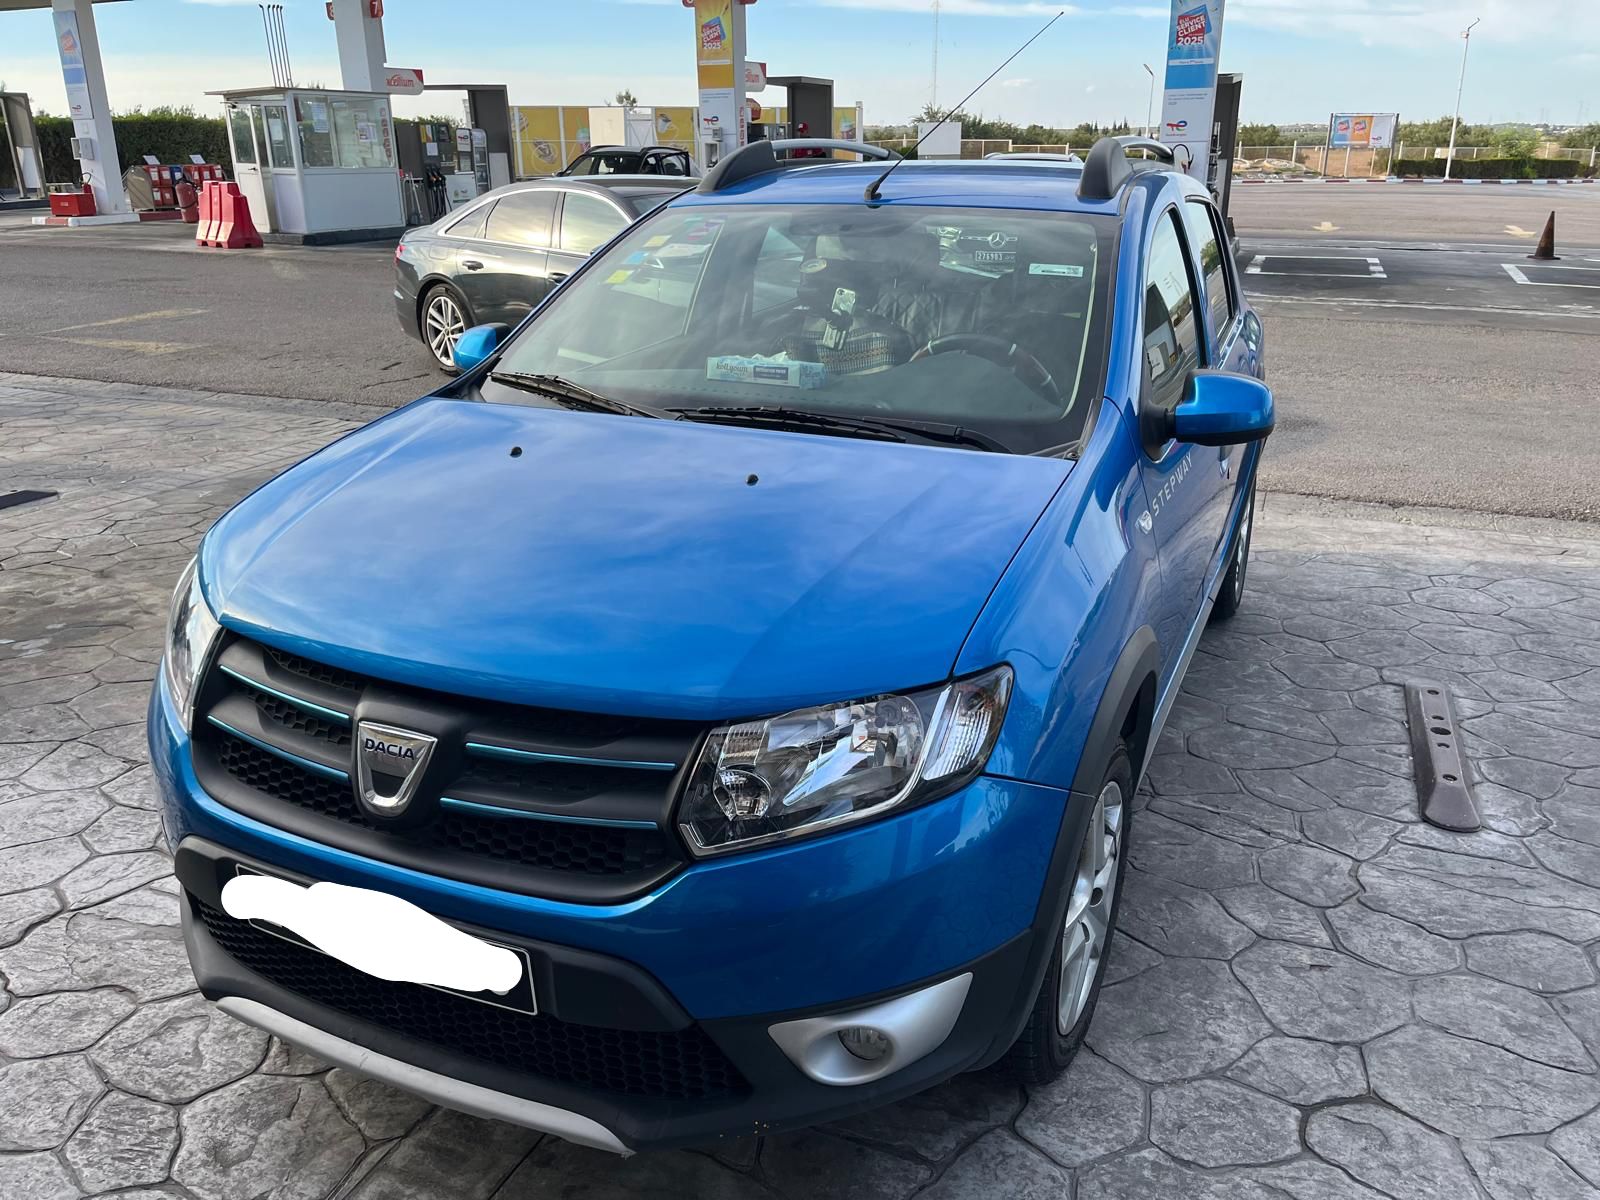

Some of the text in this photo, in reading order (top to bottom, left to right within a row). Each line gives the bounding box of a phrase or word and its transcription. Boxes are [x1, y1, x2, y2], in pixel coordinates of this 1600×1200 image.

[372, 0, 379, 15] 7
[1177, 15, 1206, 31] SERVICE
[1178, 20, 1206, 37] CLIENT
[703, 42, 722, 50] 2025
[1177, 36, 1204, 46] 2025
[1152, 451, 1192, 517] STEPWAY
[364, 737, 415, 760] DACIA
